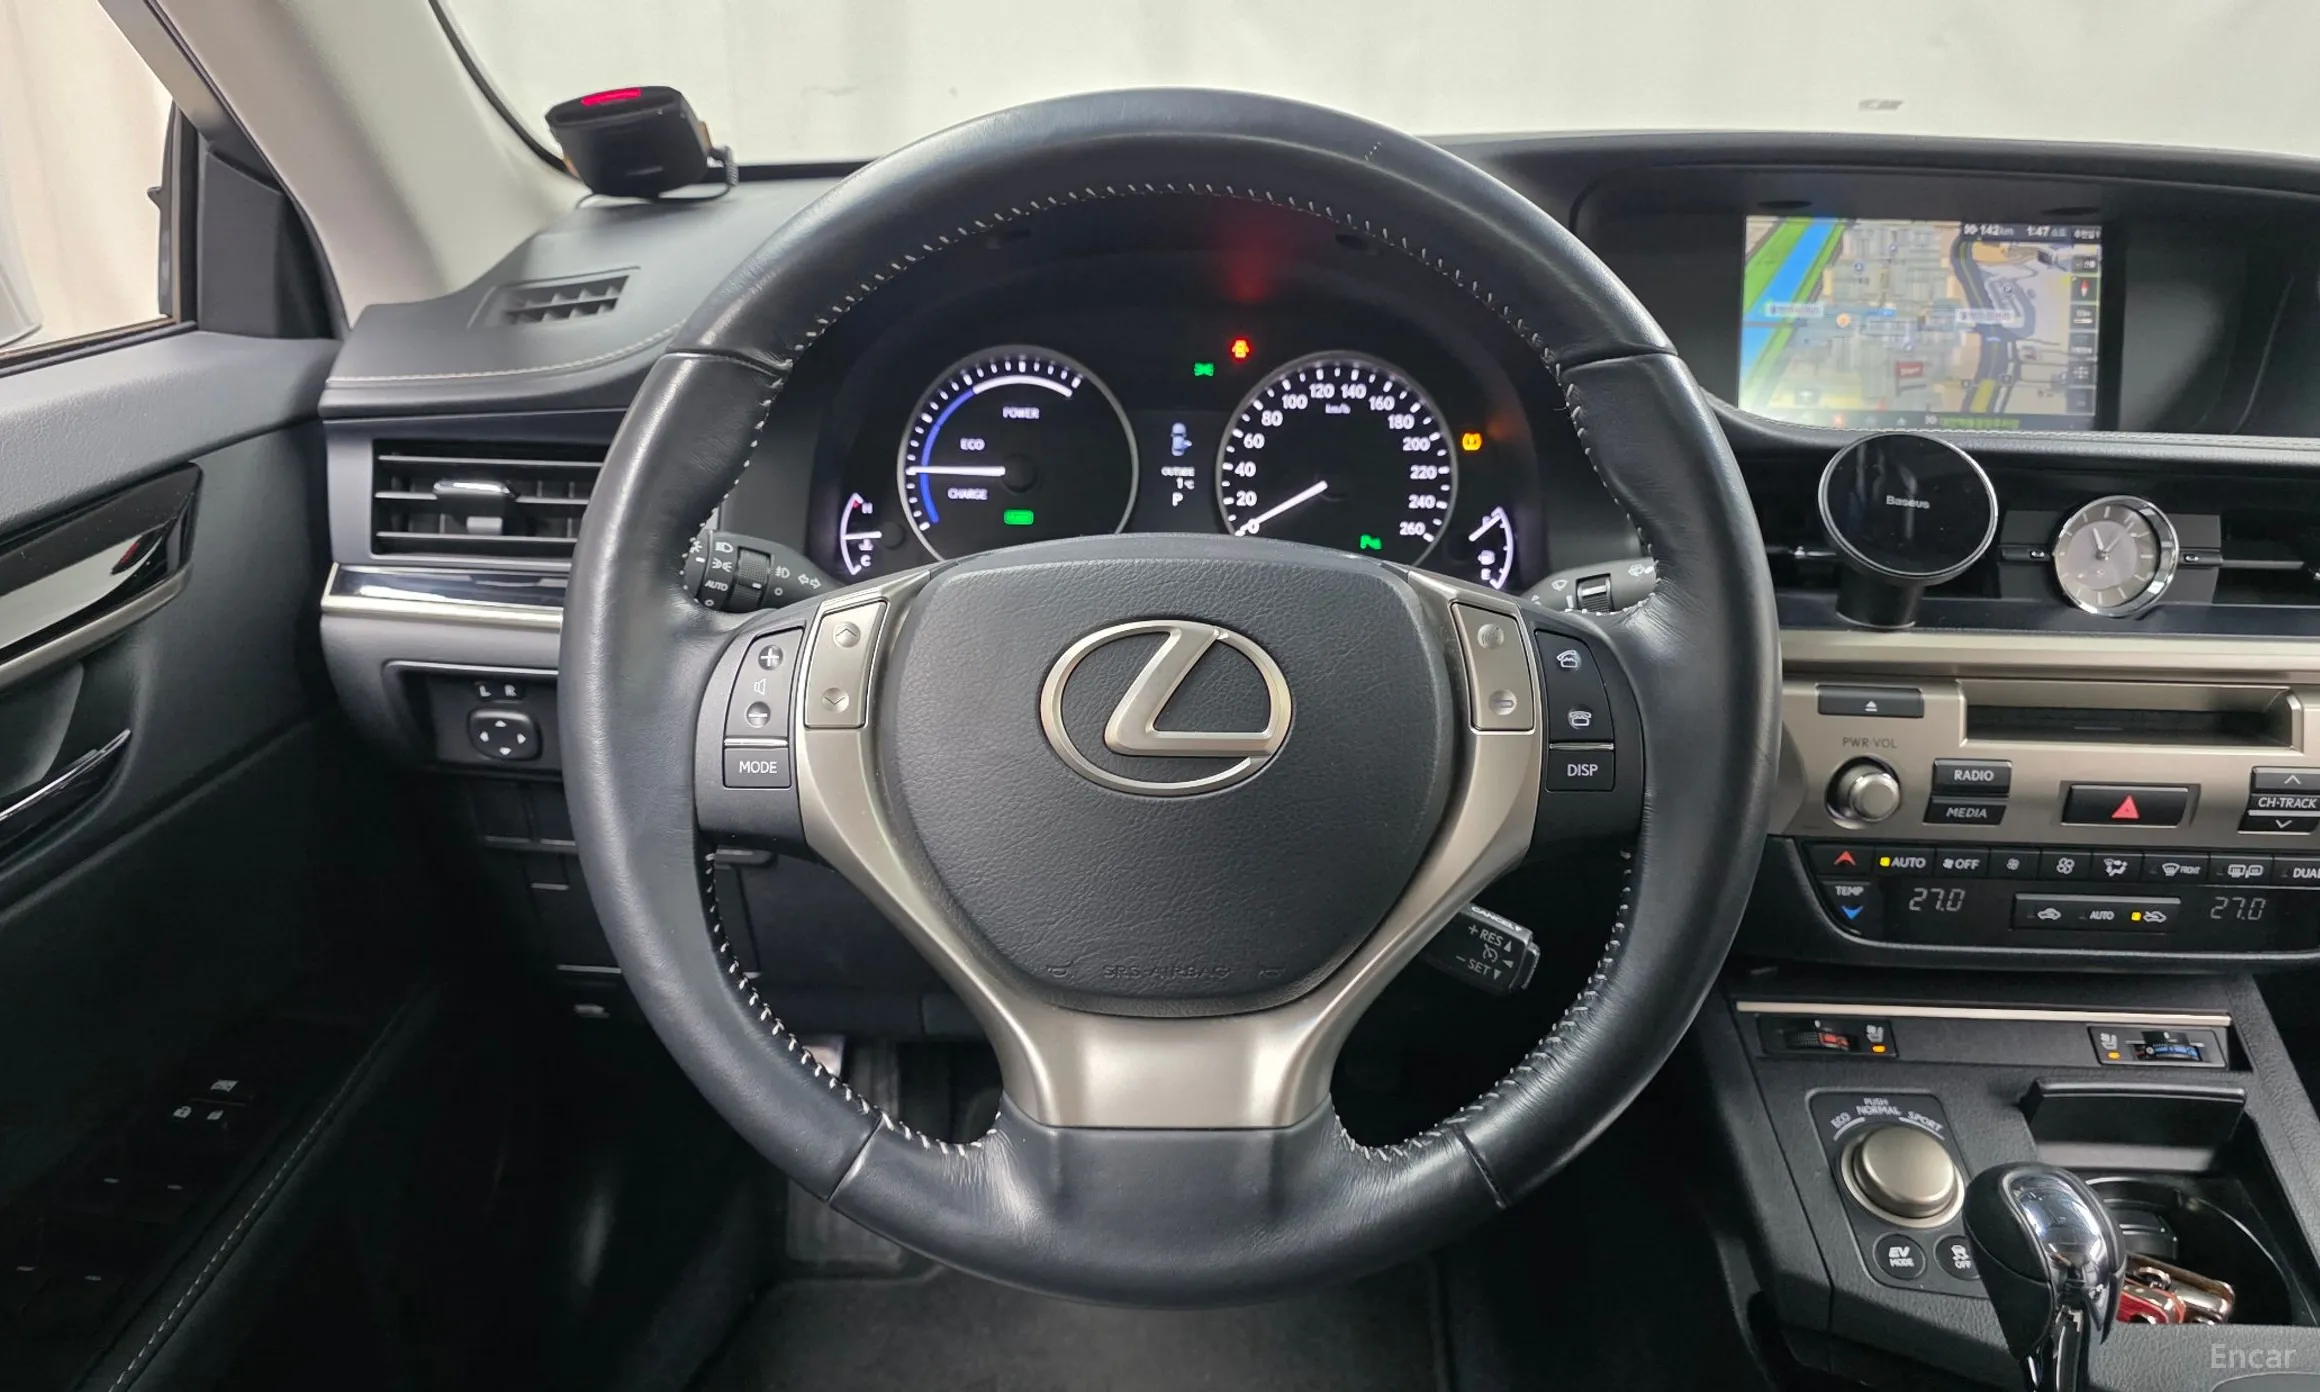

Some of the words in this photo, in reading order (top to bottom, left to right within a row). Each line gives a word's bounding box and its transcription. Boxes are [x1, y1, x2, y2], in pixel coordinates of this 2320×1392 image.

[1309, 383, 1335, 399] 120
[1341, 383, 1367, 399] 140
[1282, 394, 1308, 410] 100
[1369, 395, 1395, 411] 160
[1003, 406, 1040, 419] POWER
[1261, 410, 1283, 427] 80
[1388, 413, 1415, 430] 180
[960, 438, 985, 450] ECO
[1243, 433, 1265, 449] 60
[1403, 436, 1431, 452] 200
[1234, 461, 1257, 477] 40
[1410, 465, 1438, 480] 220
[1172, 492, 1184, 507] P
[1236, 490, 1258, 507] 20
[1408, 494, 1436, 509] 240
[1886, 495, 1931, 509] Baseus
[1247, 518, 1260, 535] 0
[1399, 521, 1426, 536] 260
[860, 554, 872, 567] C
[704, 579, 729, 592] AUTO
[739, 760, 778, 775] MODE
[1566, 763, 1599, 777] DISP
[1954, 770, 1995, 782] RADIO
[1946, 805, 1988, 819] MEDIA
[1891, 857, 1927, 869] AUTO
[1954, 858, 1980, 870] OFF
[1835, 885, 1864, 897] TEMP
[1908, 887, 1966, 912] 27.0
[2089, 910, 2115, 921] AUTO
[2210, 896, 2266, 921] 27.0
[1856, 1105, 1902, 1116] NORMAL
[1830, 1112, 1852, 1129] ECO
[1907, 1111, 1943, 1132] SPORT
[1889, 1246, 1911, 1259] EV
